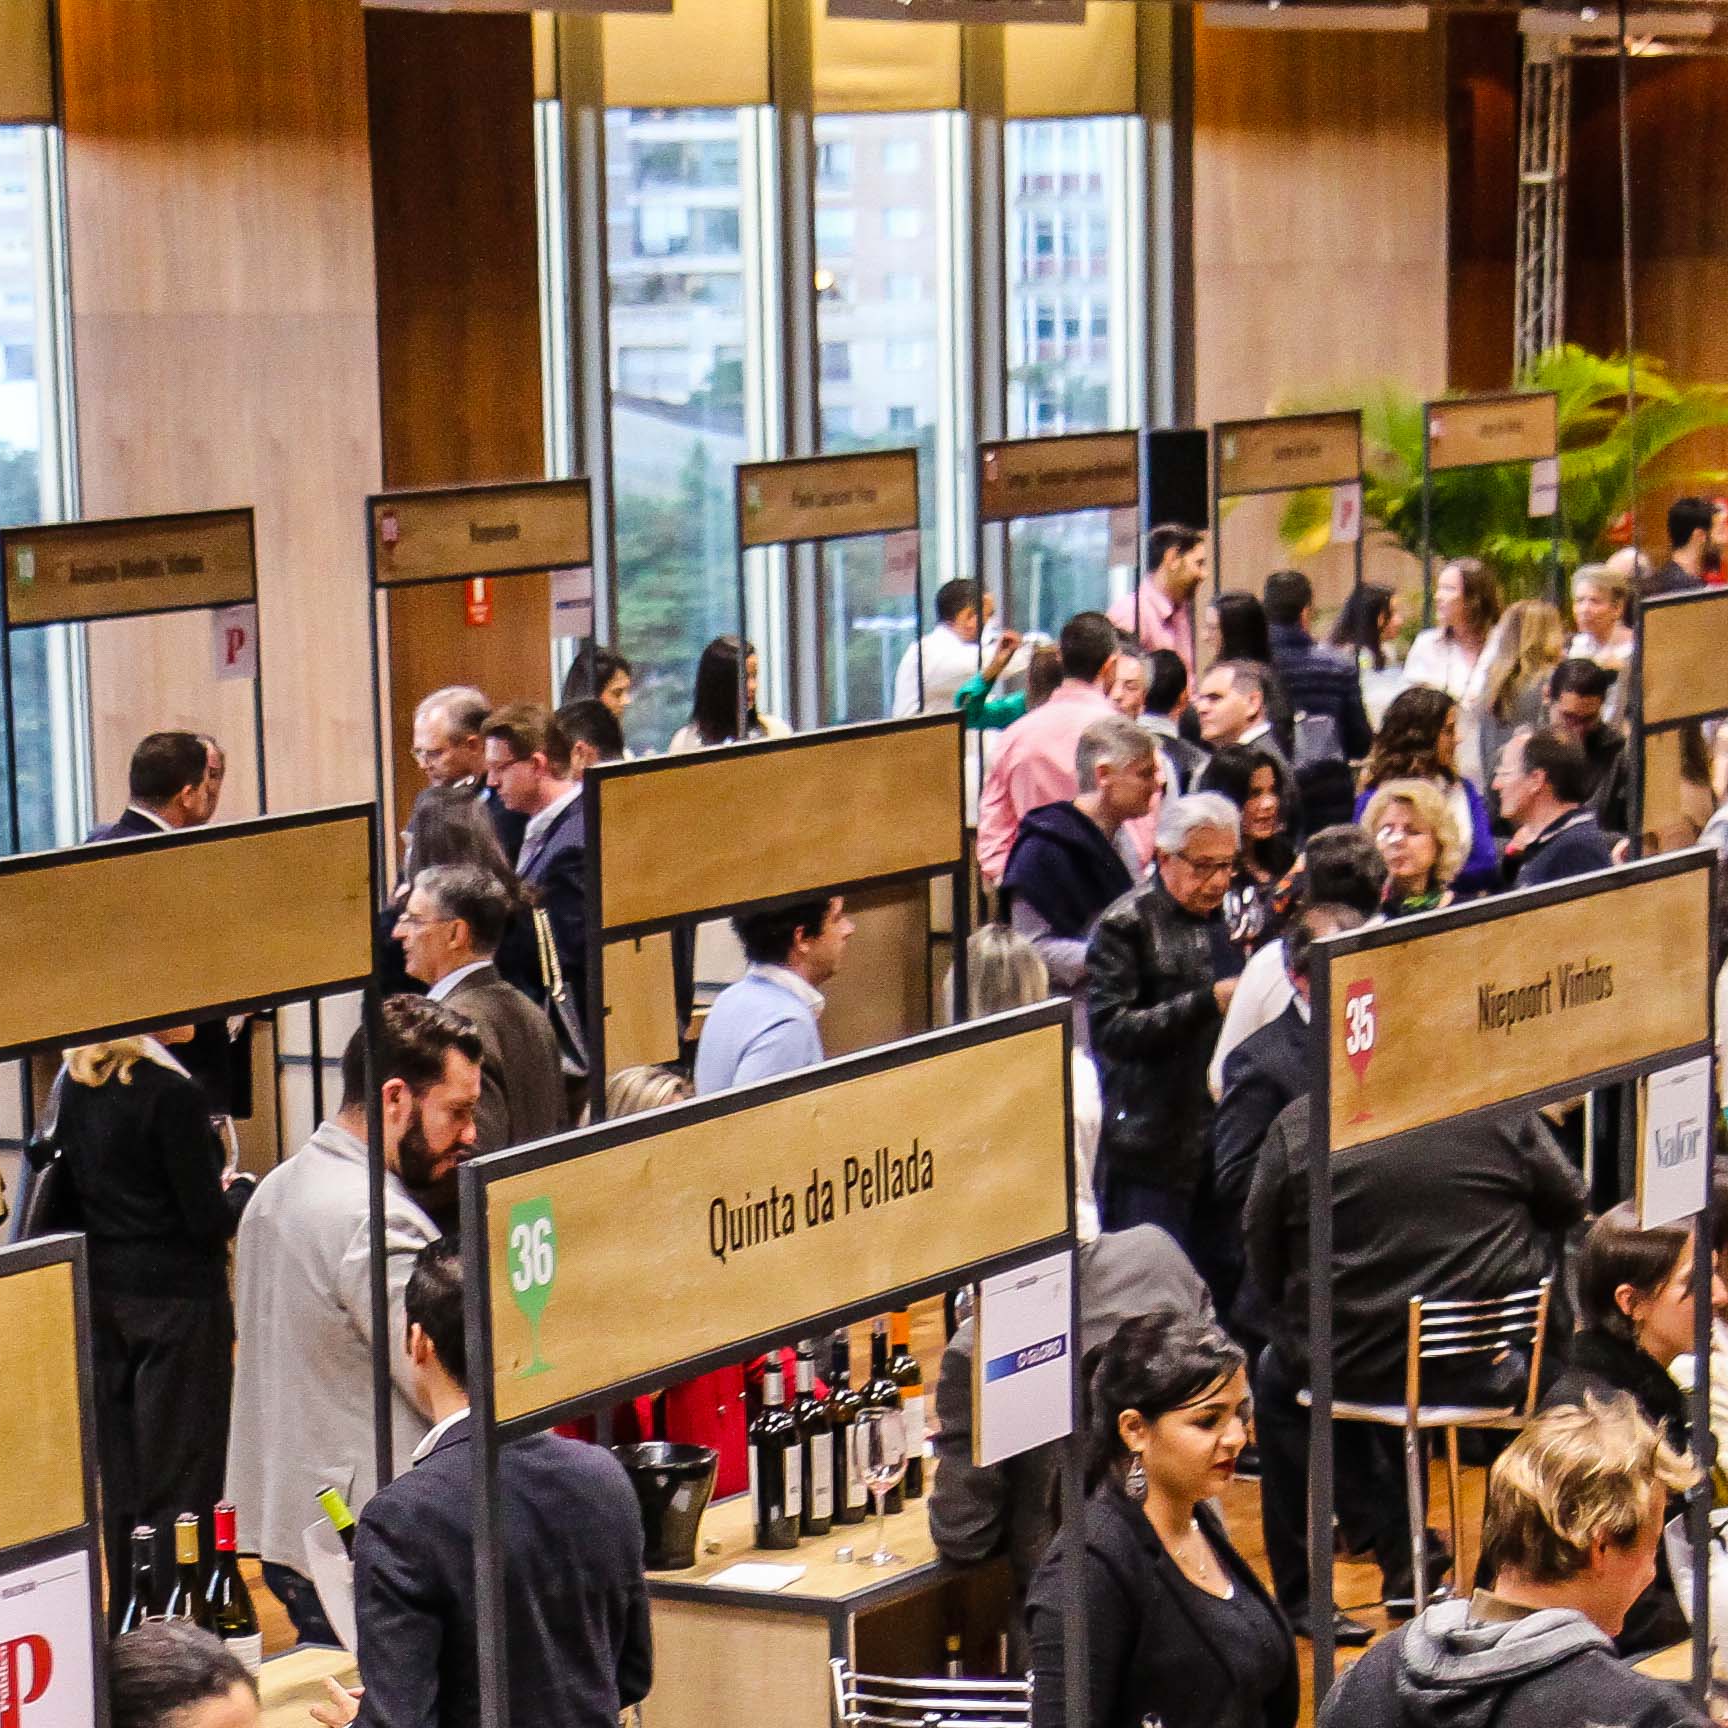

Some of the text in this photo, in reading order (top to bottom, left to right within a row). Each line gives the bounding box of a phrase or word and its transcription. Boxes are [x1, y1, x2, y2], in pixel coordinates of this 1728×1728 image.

[1345, 992, 1374, 1057] 35
[1477, 955, 1614, 1034] Niepoort Vinhos
[709, 1137, 934, 1265] Quinta da Pellada
[510, 1216, 553, 1293] 36
